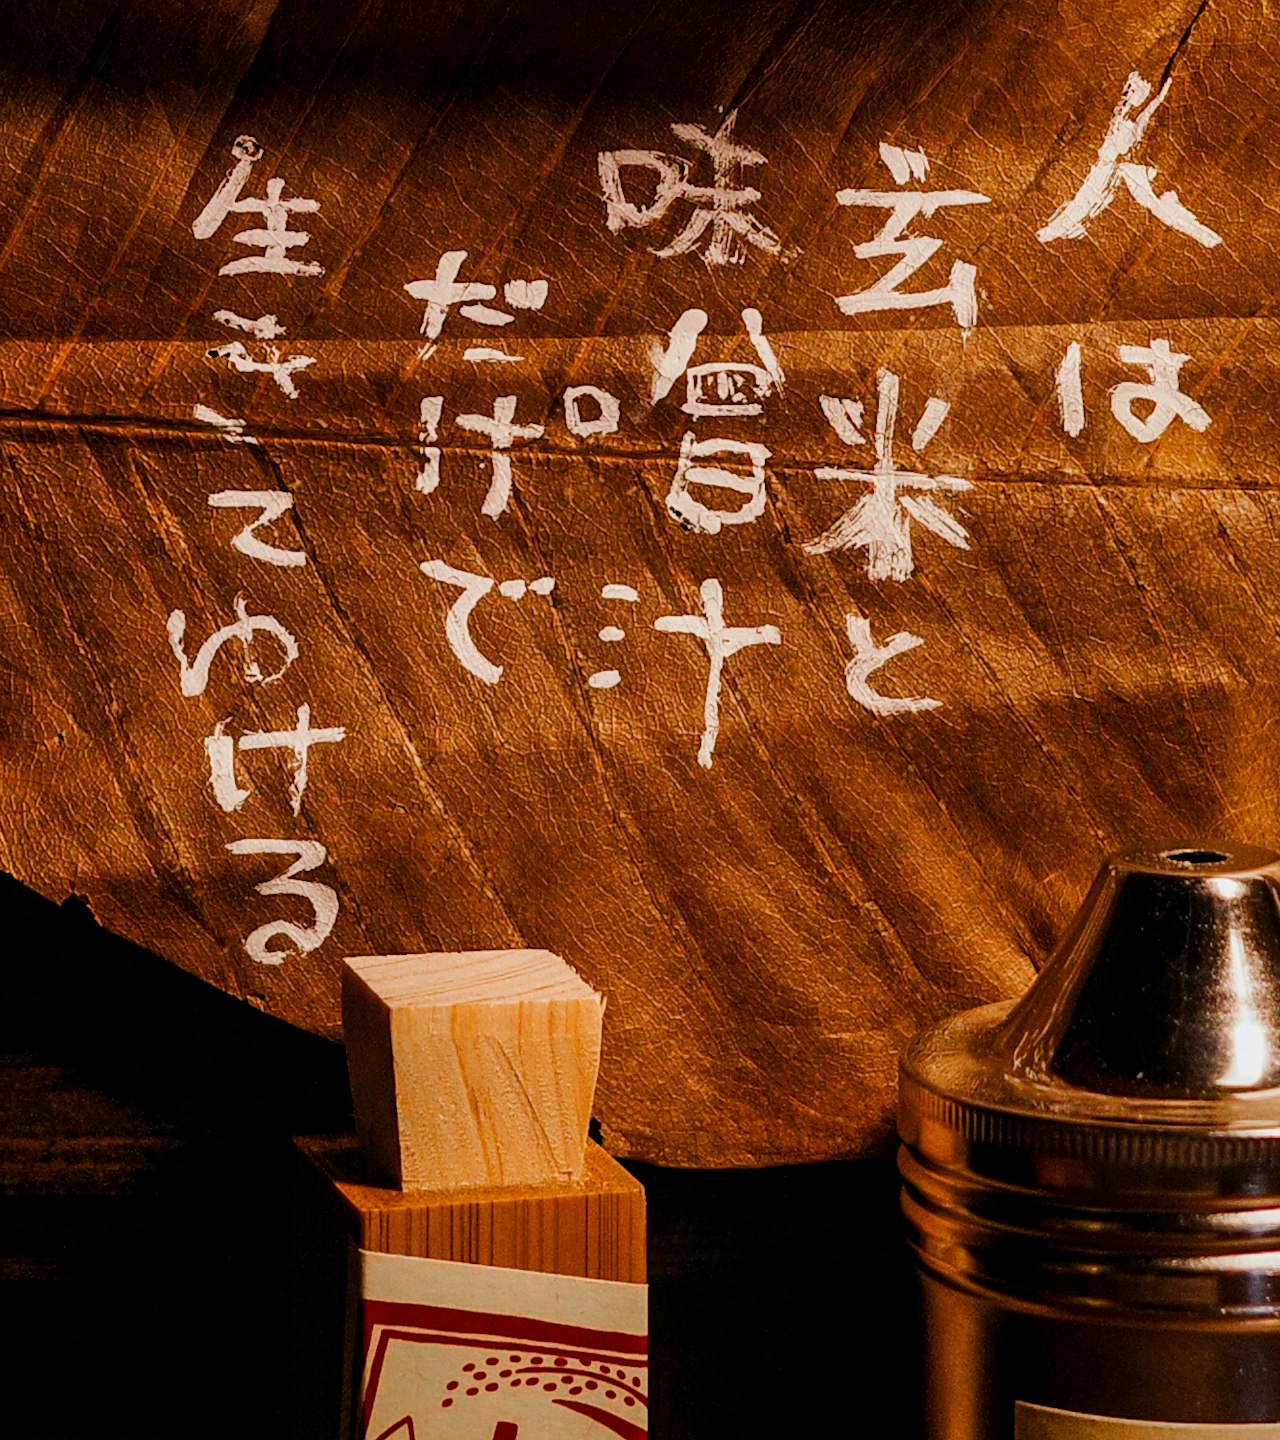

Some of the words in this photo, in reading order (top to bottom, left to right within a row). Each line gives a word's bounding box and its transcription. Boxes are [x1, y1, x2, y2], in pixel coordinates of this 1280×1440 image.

[404, 248, 557, 686] だけで
[803, 140, 992, 716] 玄米と
[1038, 70, 1222, 438] 人は
[166, 135, 346, 966] 生きてゆける
